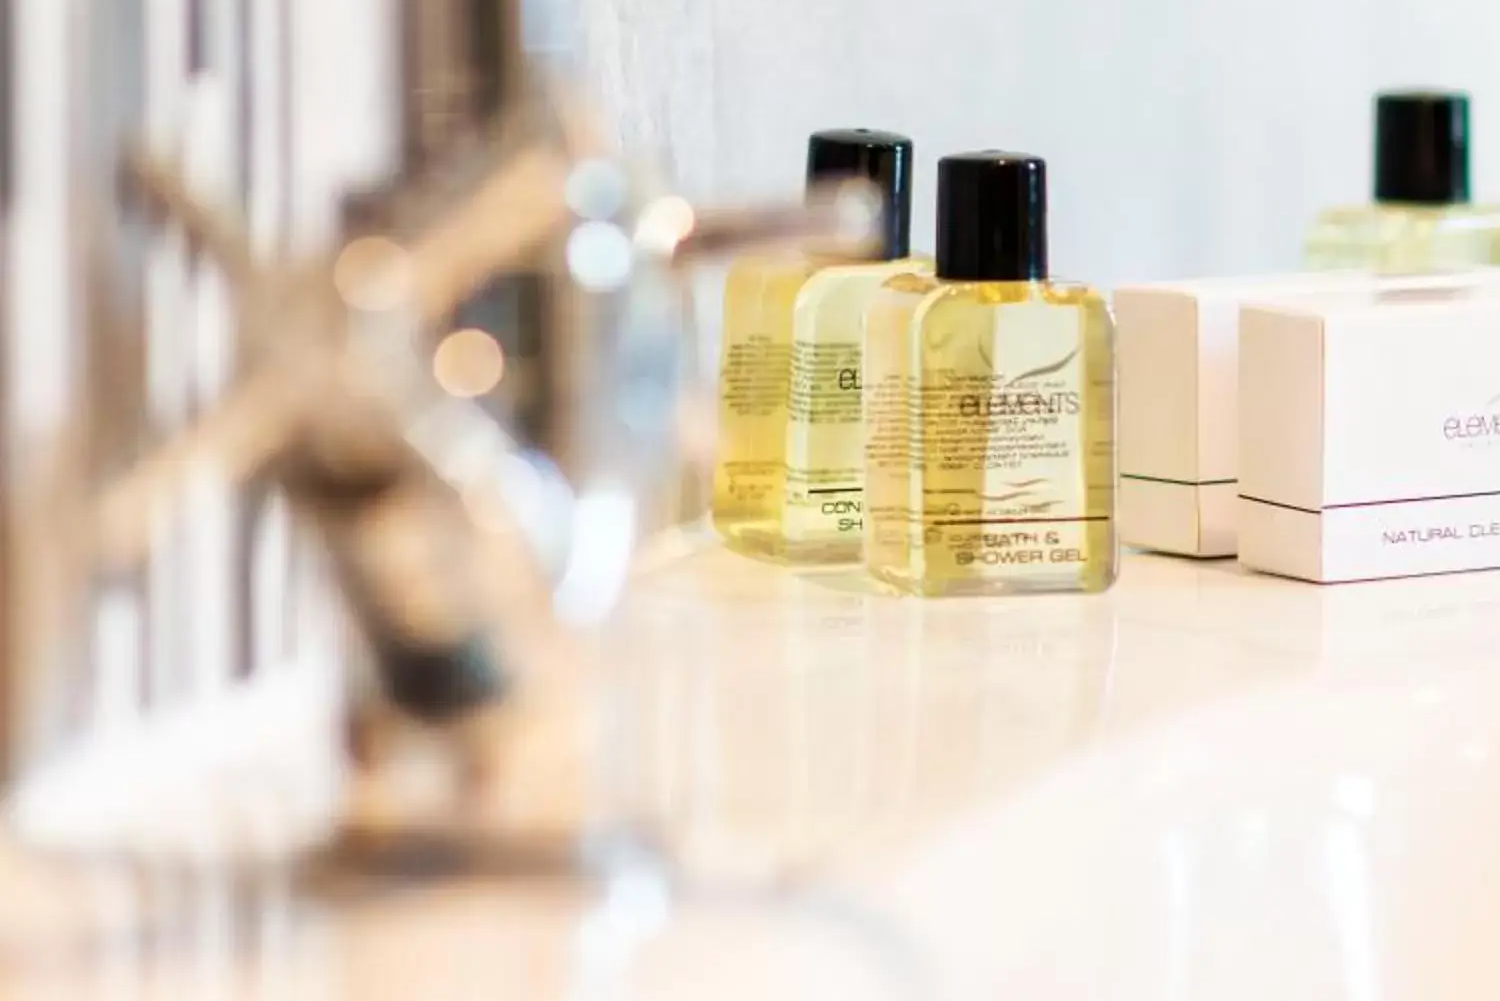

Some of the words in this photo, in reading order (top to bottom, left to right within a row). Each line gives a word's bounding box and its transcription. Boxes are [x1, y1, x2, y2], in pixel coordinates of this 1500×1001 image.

[984, 531, 1038, 548] BATH
[1045, 530, 1061, 544] &
[1382, 527, 1463, 544] NATURAL
[955, 550, 1043, 566] SHOWER
[1050, 547, 1089, 561] GEL
